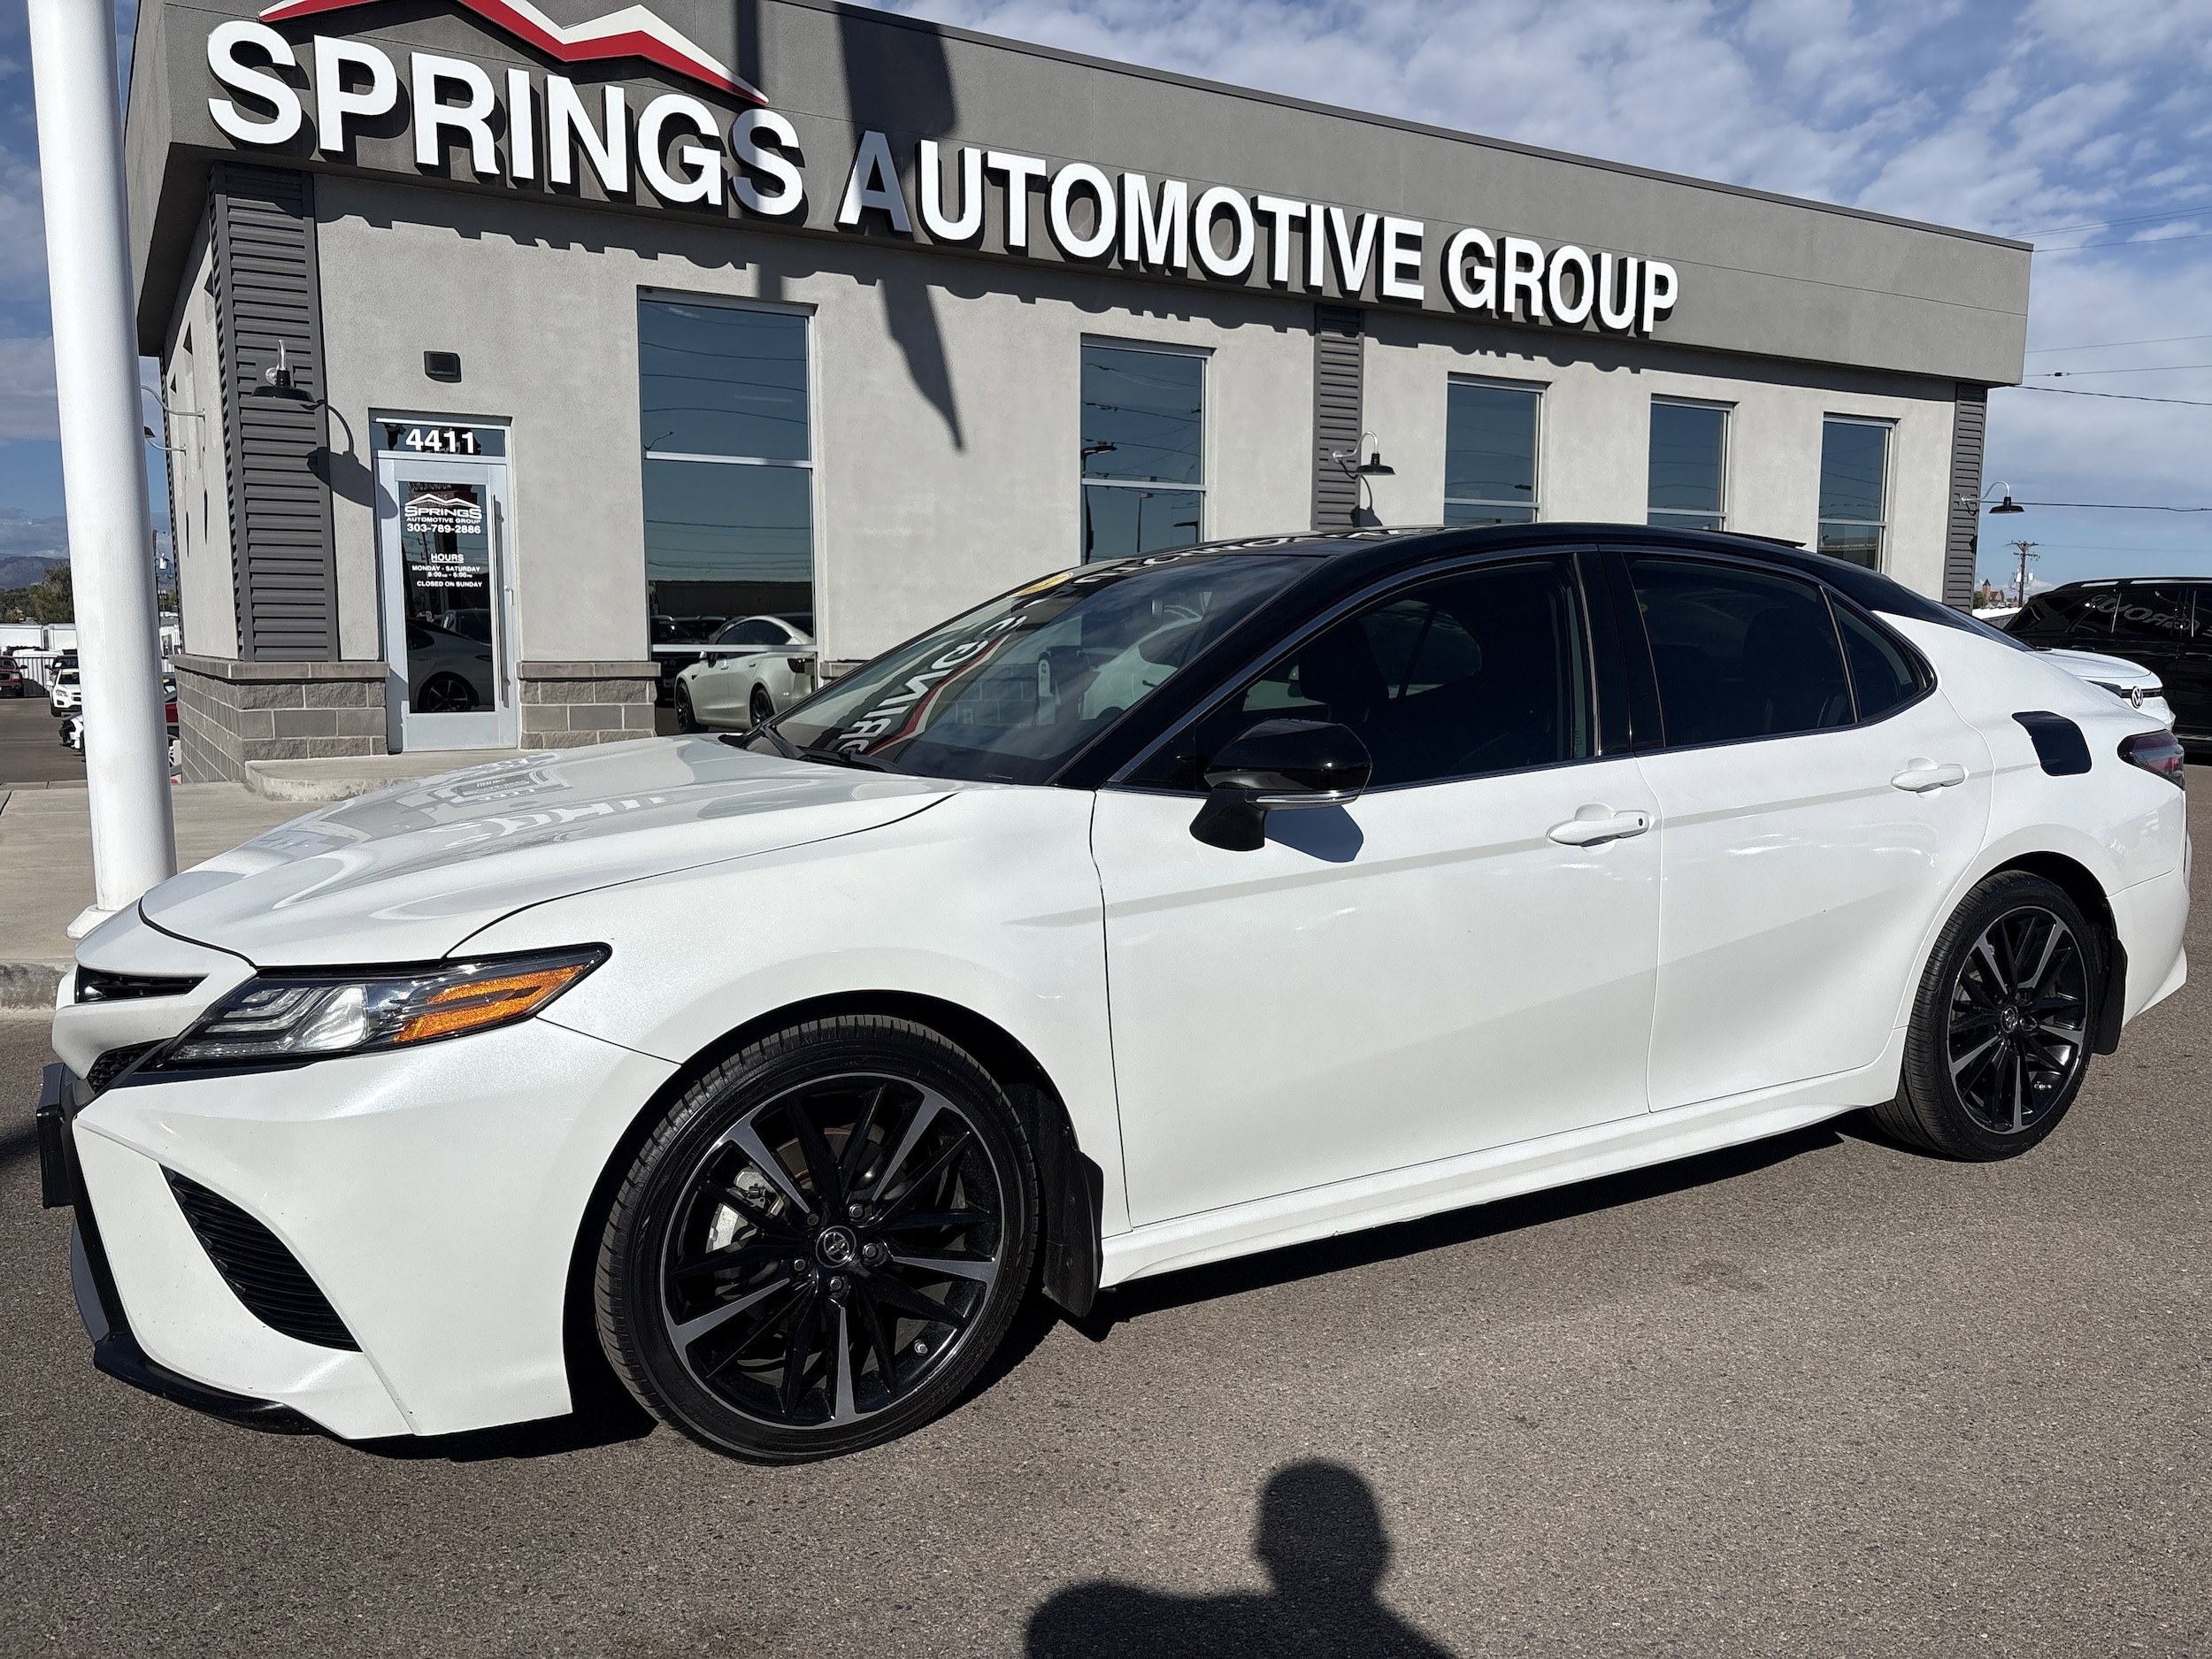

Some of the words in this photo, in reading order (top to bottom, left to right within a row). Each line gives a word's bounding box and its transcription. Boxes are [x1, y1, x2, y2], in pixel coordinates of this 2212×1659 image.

[207, 20, 803, 217] SPRINGS
[837, 130, 1425, 300] AUTOMOTIVE
[1447, 227, 1679, 334] GROUP
[405, 428, 474, 454] 4411
[404, 505, 482, 520] SPRINGS
[406, 523, 481, 534] 303-789-2886
[431, 553, 465, 562] HOURS
